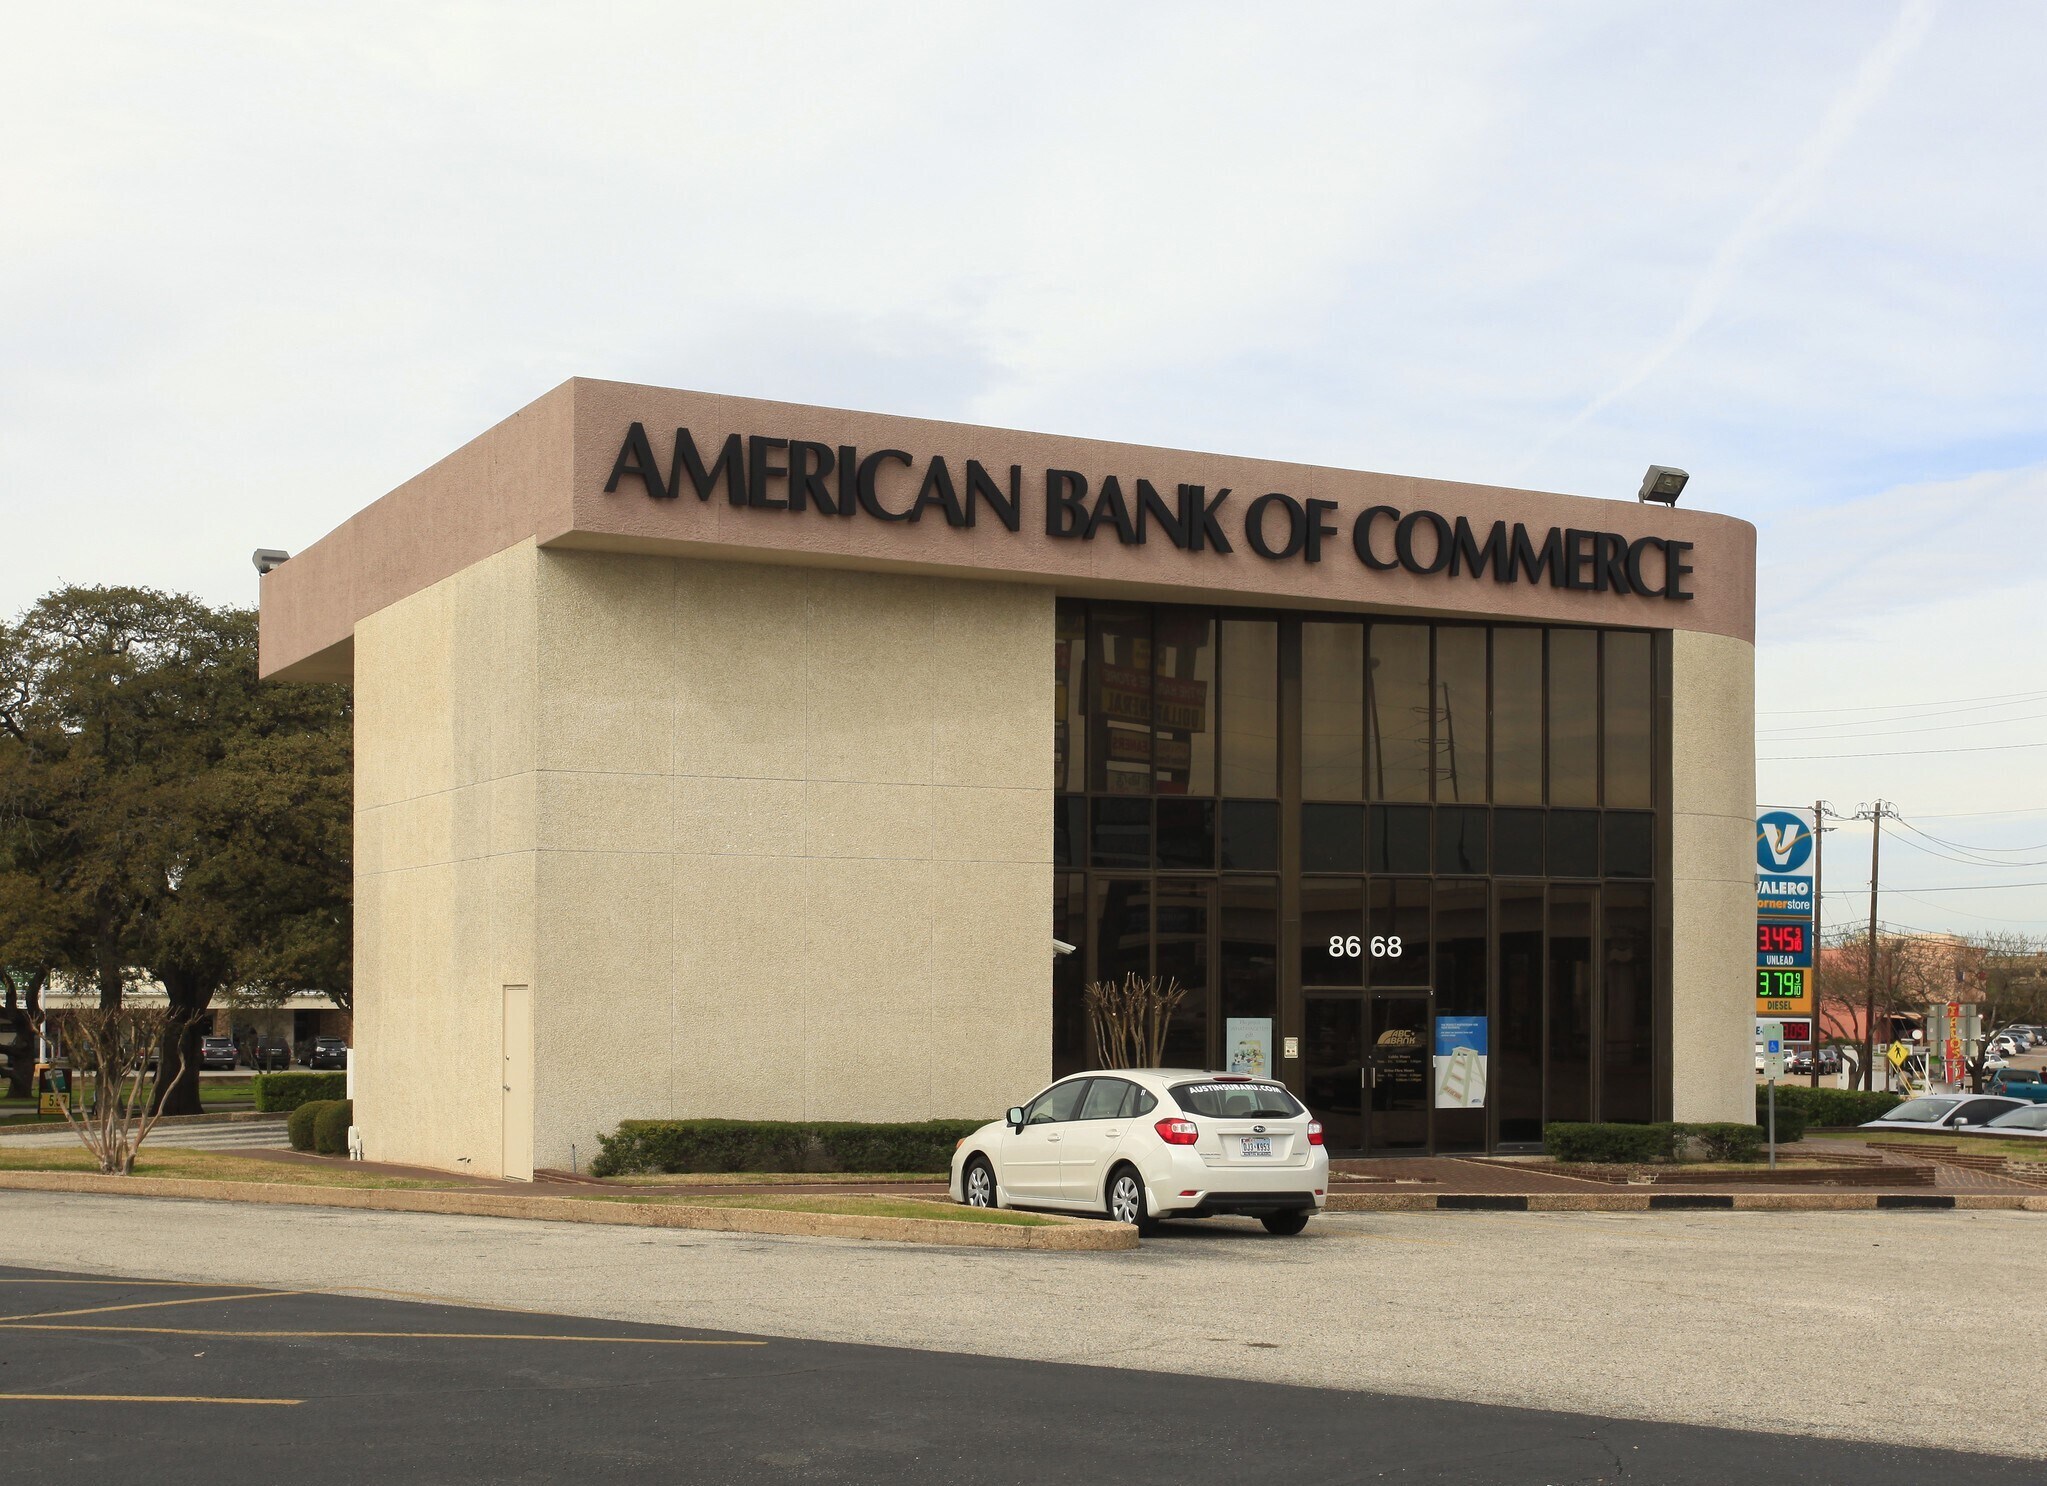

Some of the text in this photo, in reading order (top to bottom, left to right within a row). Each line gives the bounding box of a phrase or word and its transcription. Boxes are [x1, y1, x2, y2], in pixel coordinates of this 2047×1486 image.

[603, 421, 1695, 600] AMERICAN BANK OF COMMERCE
[1757, 898, 1810, 910] ornerstore
[1760, 926, 1794, 951] 3.45
[1766, 955, 1794, 966] UNLEAD
[1760, 972, 1794, 996] 3.79
[1767, 1001, 1793, 1010] DIESEL
[1392, 1029, 1411, 1037] ABC
[1189, 1084, 1282, 1095] AUSTINSUBARU.COM
